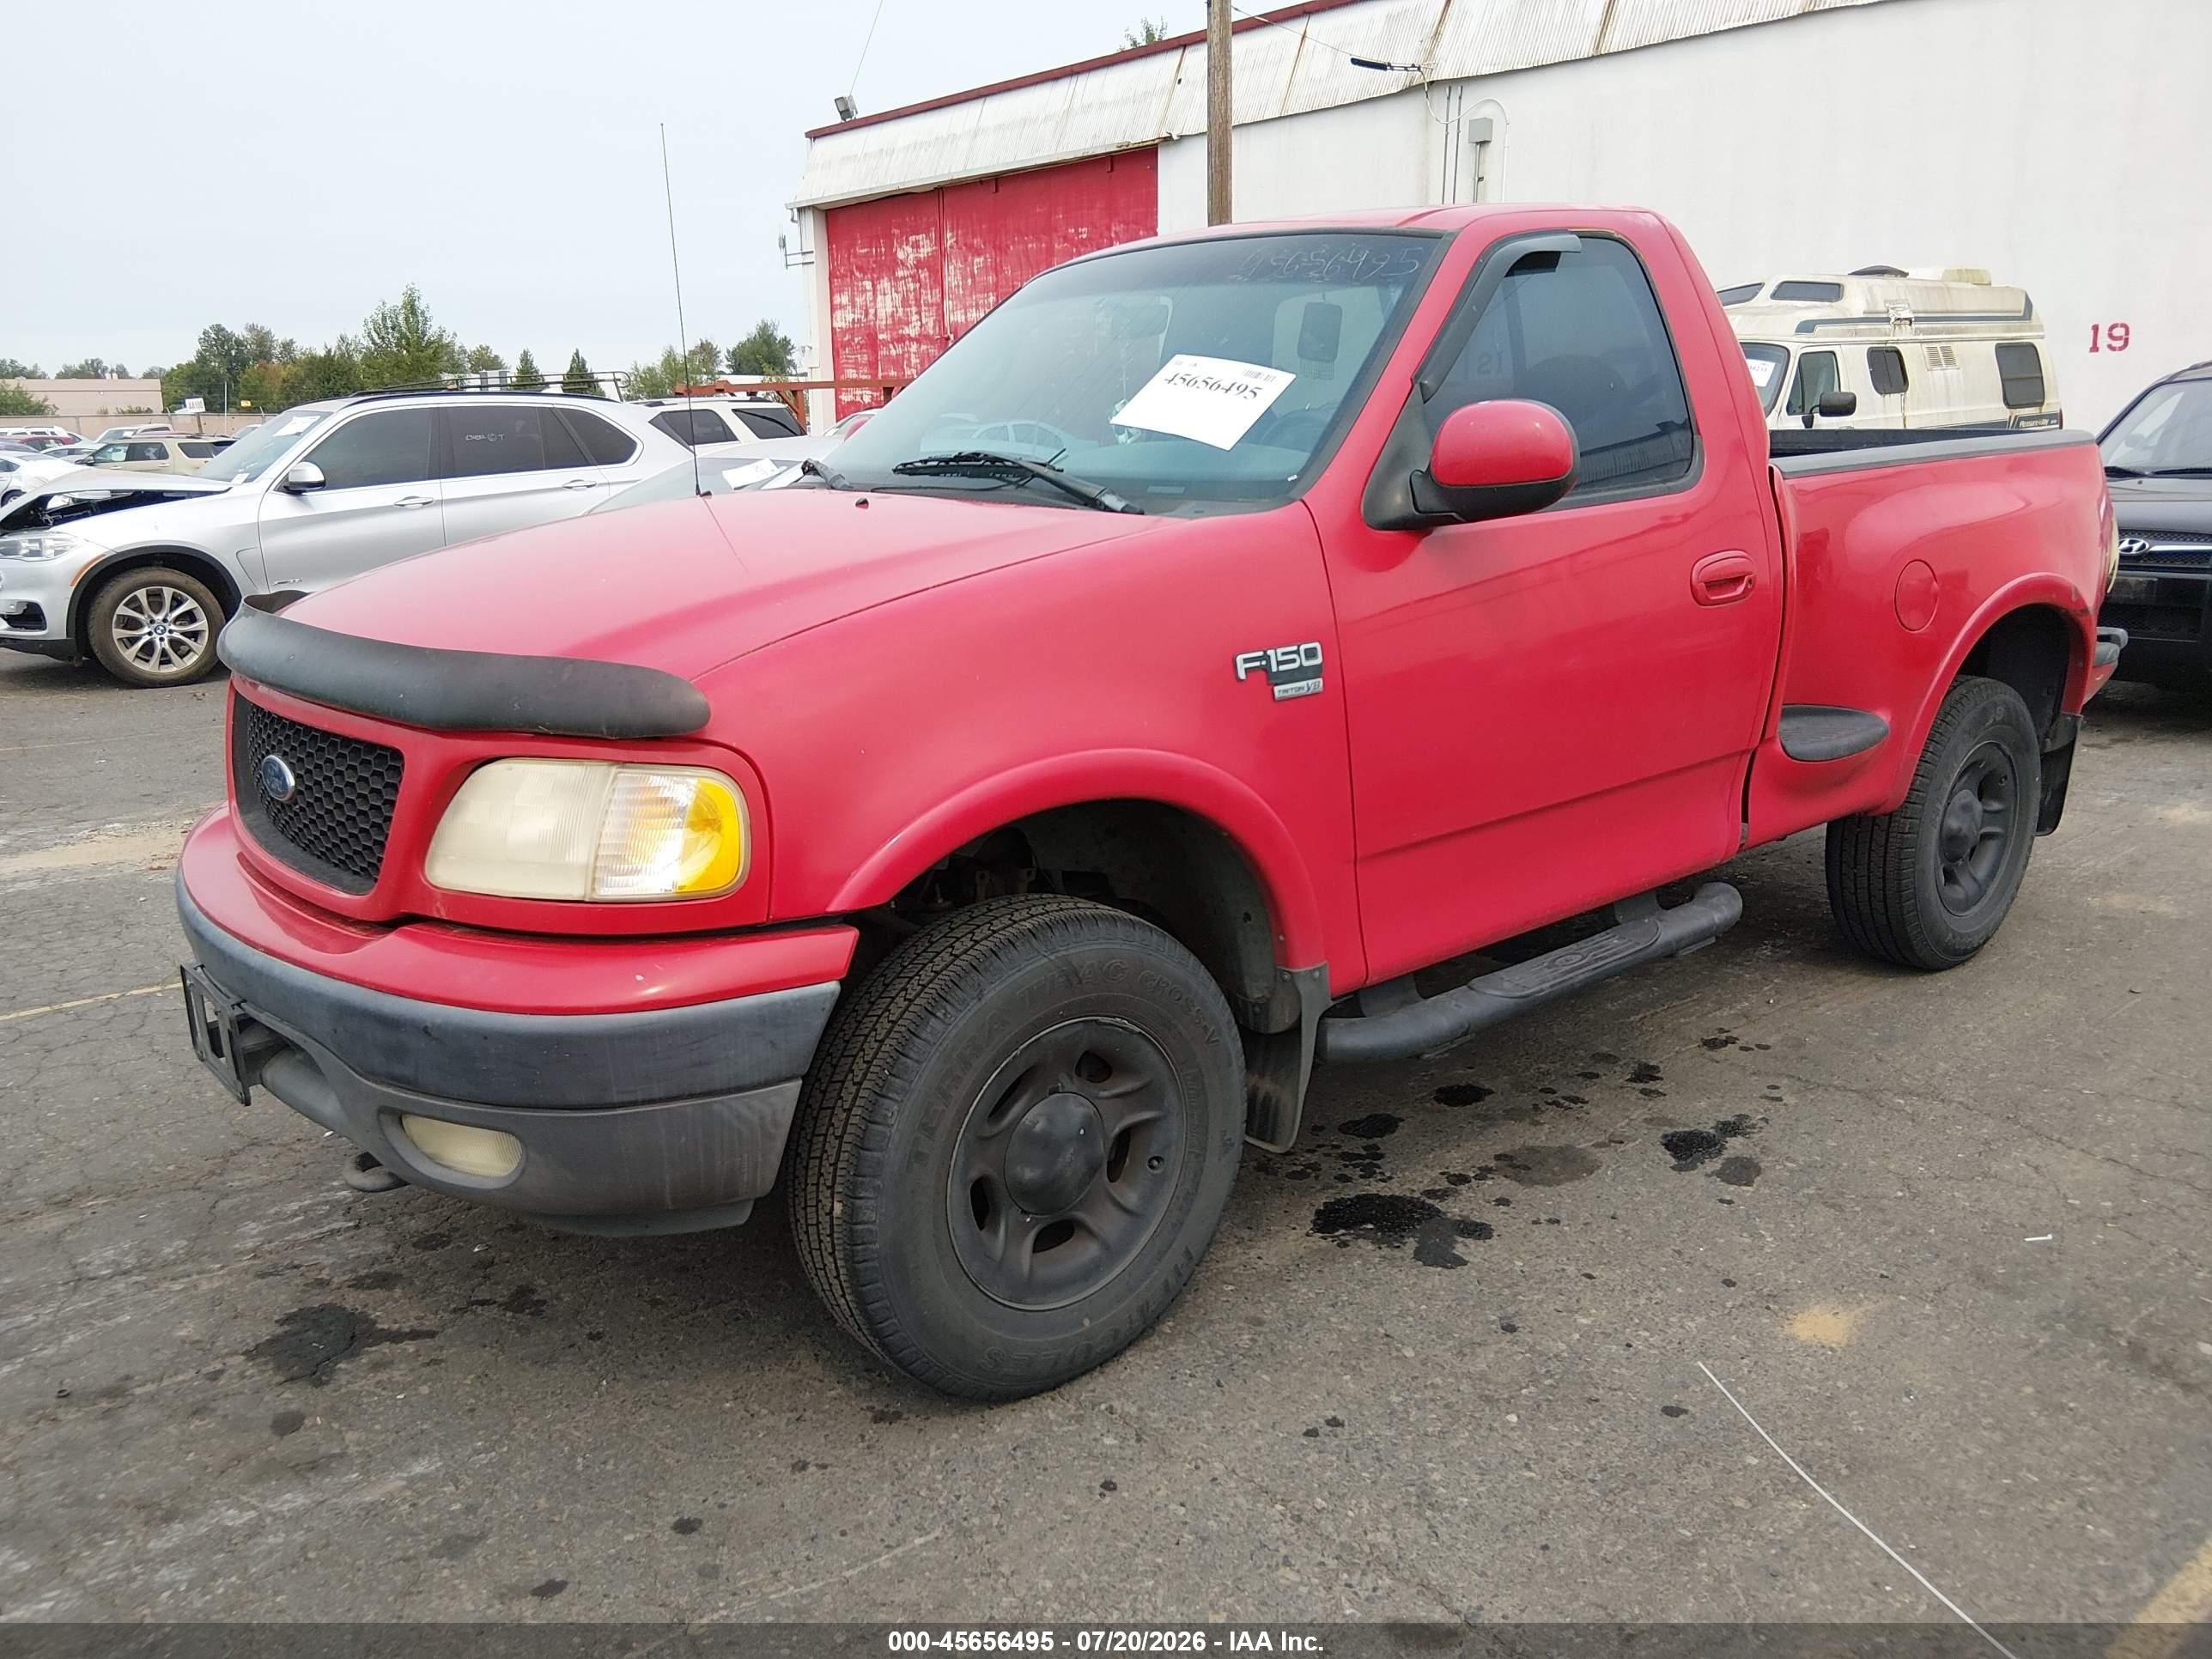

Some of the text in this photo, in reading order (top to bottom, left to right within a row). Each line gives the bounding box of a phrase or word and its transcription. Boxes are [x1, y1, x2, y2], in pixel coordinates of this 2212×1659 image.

[2088, 323, 2130, 354] 19
[1164, 372, 1263, 399] 45656495
[1305, 679, 1322, 694] V8
[1137, 969, 1221, 1048] CROSS-V
